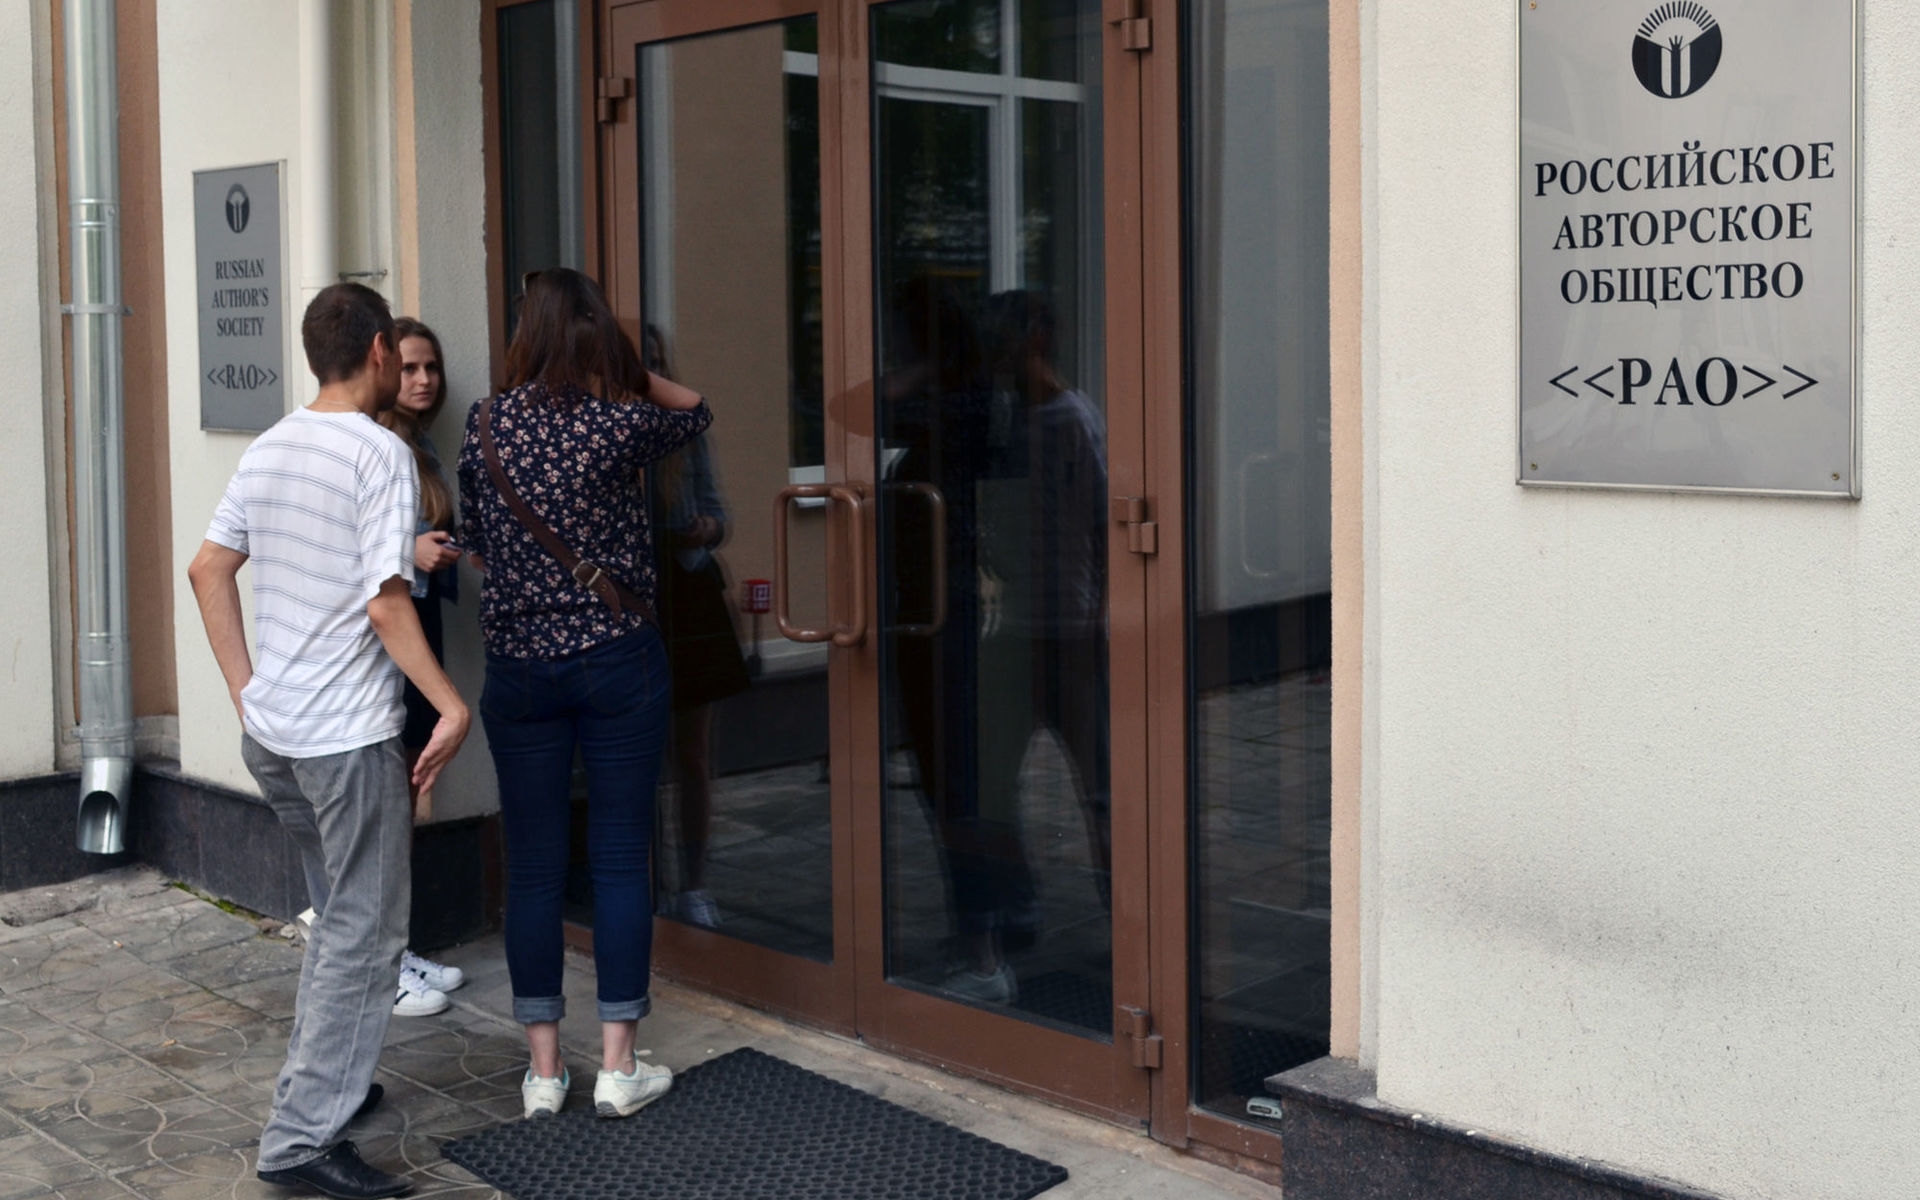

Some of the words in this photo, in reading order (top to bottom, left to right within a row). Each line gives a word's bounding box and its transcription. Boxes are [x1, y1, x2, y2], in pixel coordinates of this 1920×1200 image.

[1534, 140, 1835, 197] РОССИЙСКОЕ
[1552, 202, 1813, 250] АВТОРСКОЕ
[215, 258, 265, 280] RUSSIAN
[1560, 261, 1804, 309] ОБЩЕСТВО
[211, 287, 269, 309] AUTHOR'S
[216, 317, 265, 337] SOCIETY
